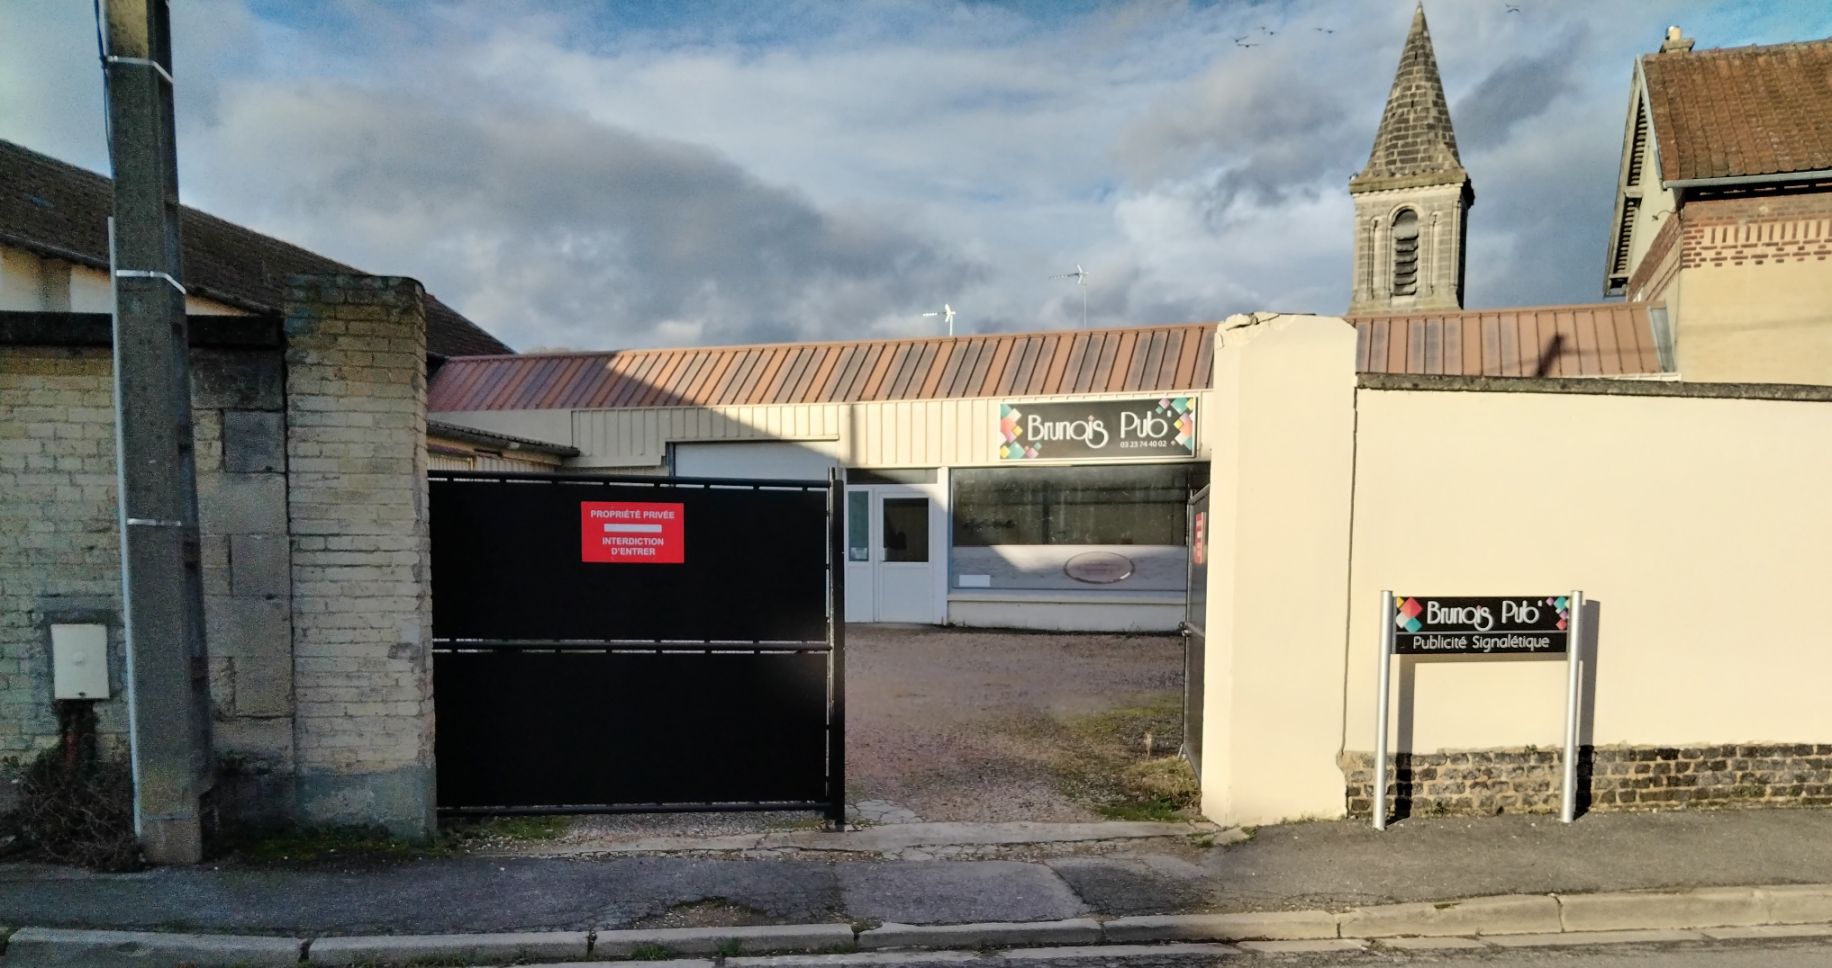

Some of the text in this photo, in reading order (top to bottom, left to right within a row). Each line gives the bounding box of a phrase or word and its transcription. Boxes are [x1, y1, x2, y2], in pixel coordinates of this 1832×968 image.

[1028, 414, 1109, 448] Brunois
[1149, 440, 1158, 448] 40
[591, 510, 675, 519] PROPRIÉTÉ PRIVÉE
[602, 537, 664, 546] INTERDICTION
[611, 547, 656, 556] D'ENTRER
[1427, 600, 1494, 632] Brunois
[1413, 634, 1550, 651] Publicité Signalétique
